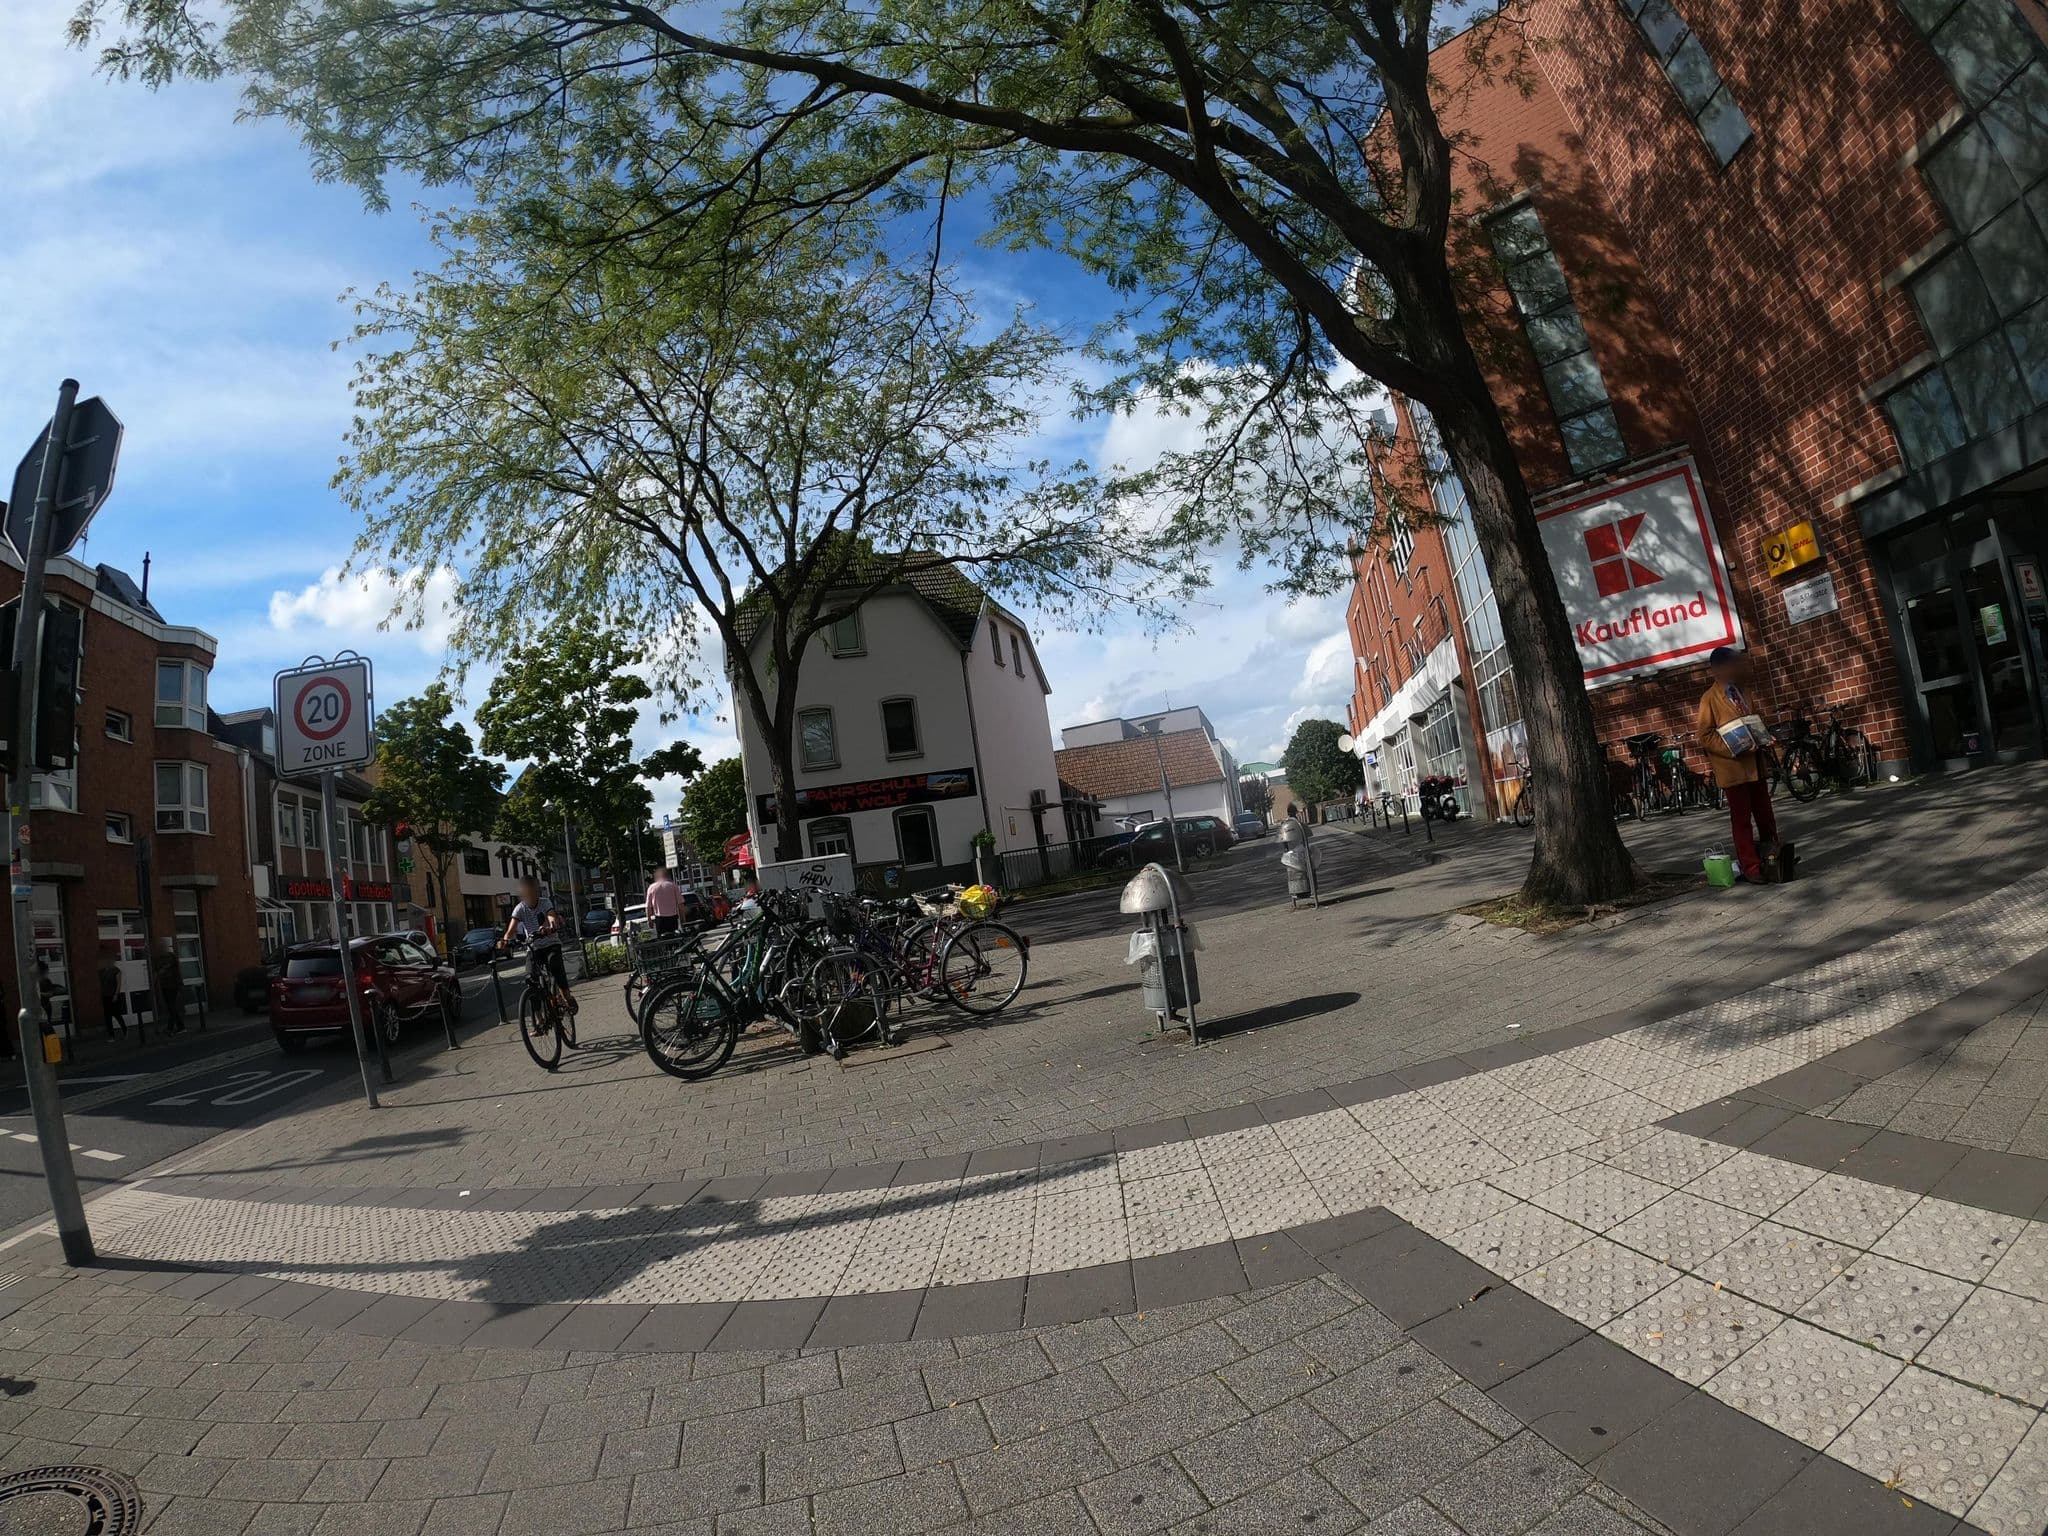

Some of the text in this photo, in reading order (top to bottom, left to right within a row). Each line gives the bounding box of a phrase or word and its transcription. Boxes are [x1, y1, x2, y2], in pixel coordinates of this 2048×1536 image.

[1576, 591, 1707, 647] Kaufland
[307, 693, 339, 724] 20
[303, 742, 346, 762] ZONE
[805, 775, 928, 800] FAHRSCHULE
[857, 792, 908, 808] WOLF
